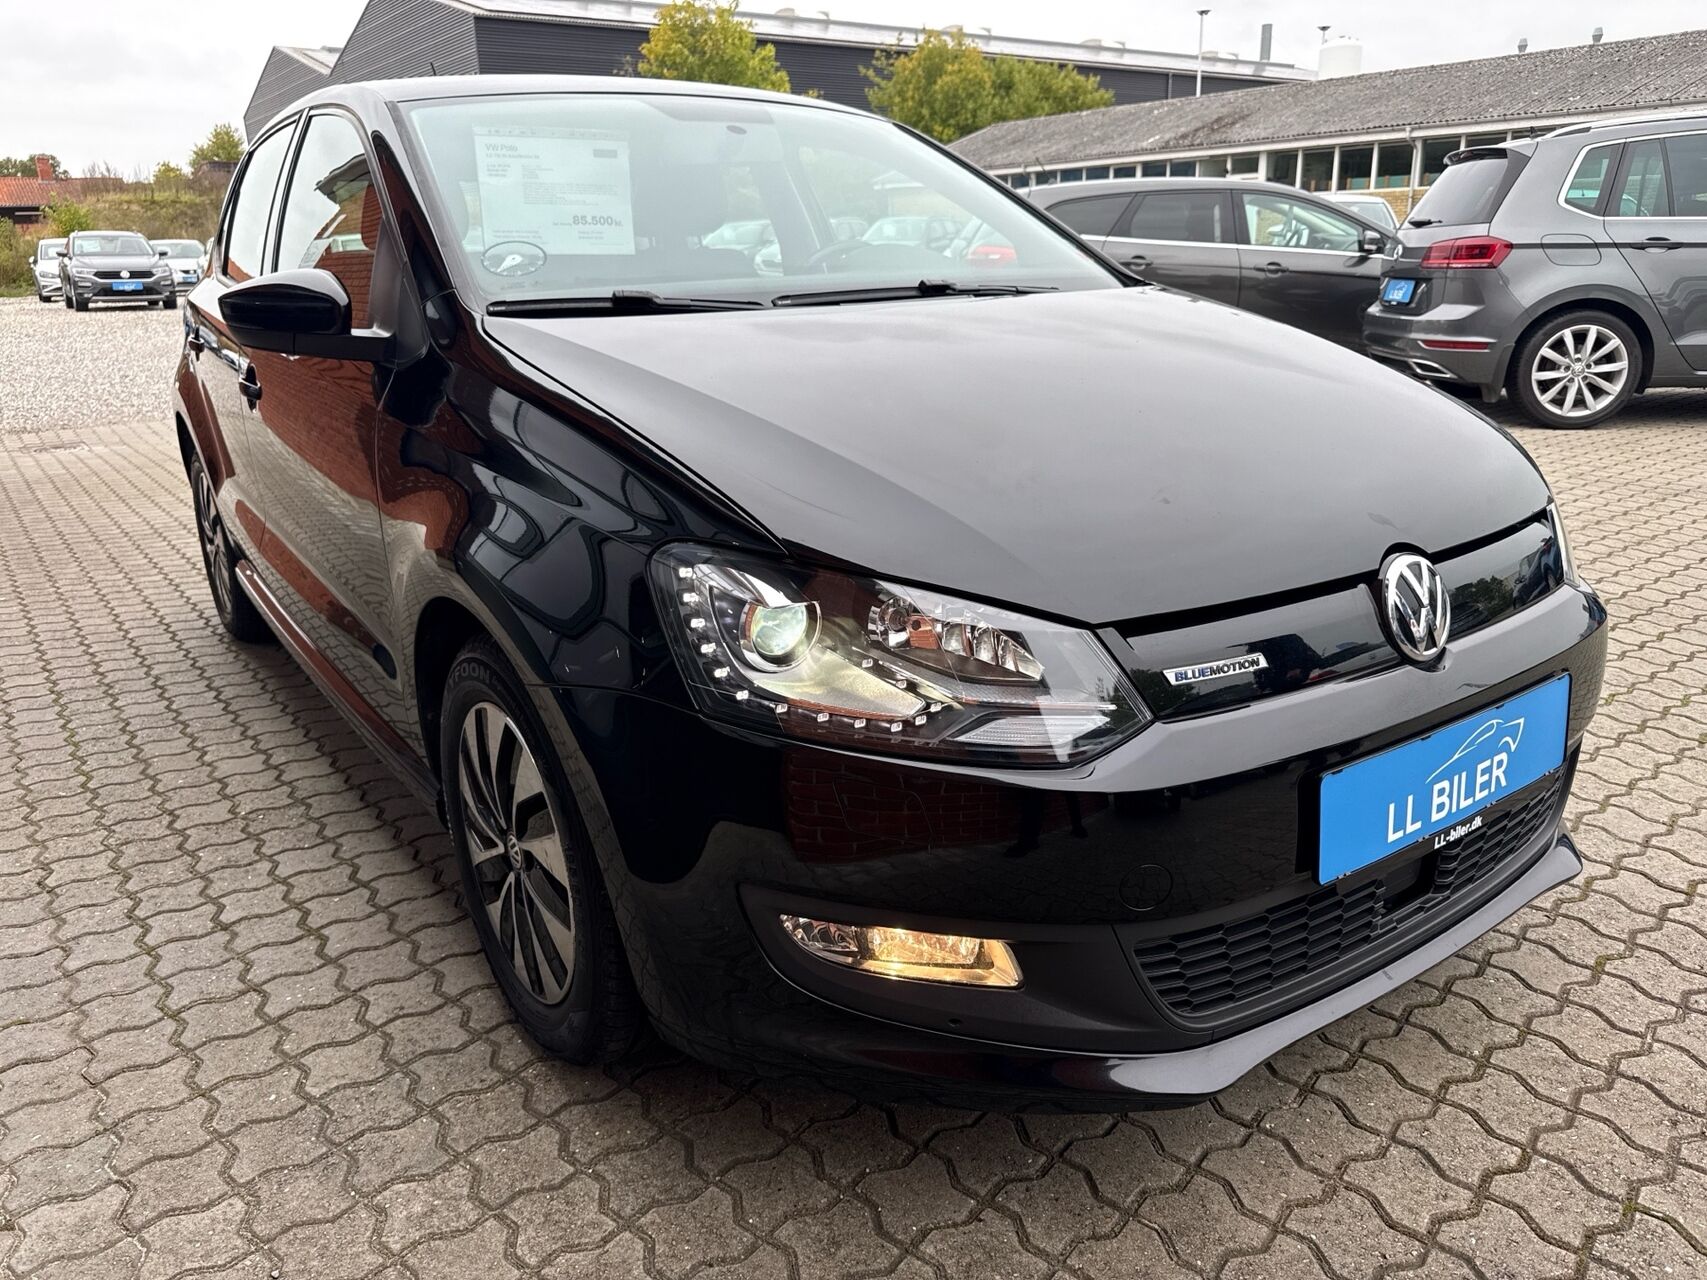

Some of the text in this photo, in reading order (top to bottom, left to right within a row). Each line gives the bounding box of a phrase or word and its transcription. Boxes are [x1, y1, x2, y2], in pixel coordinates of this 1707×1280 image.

[572, 214, 613, 226] 85.500
[1174, 657, 1260, 683] BLUEMOTION
[1387, 751, 1508, 843] LL BILER
[1433, 816, 1483, 850] LL-biler.dk
